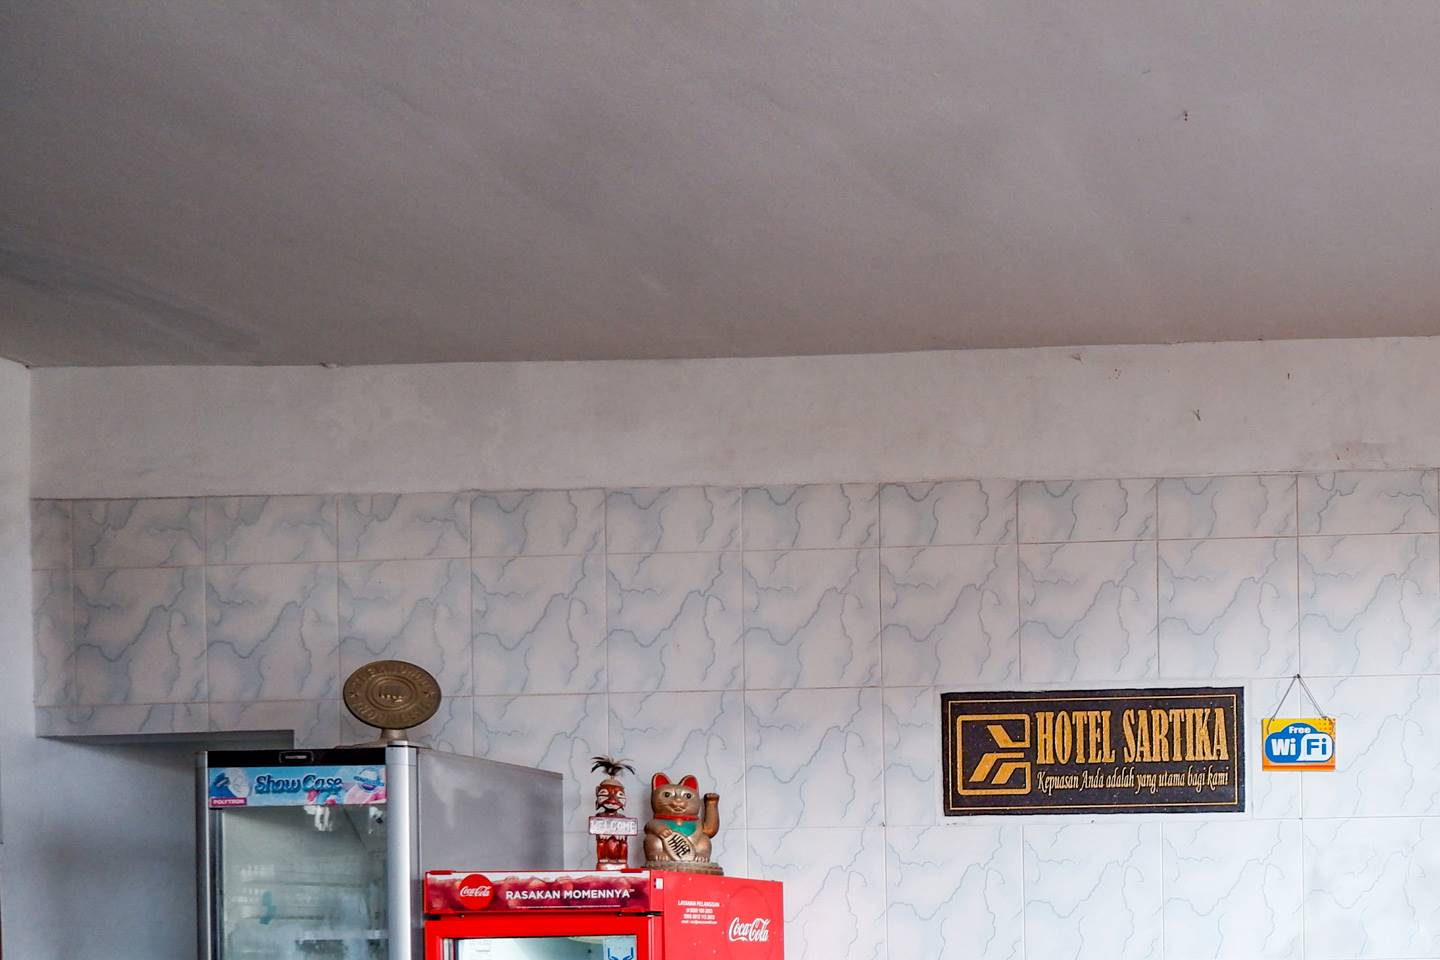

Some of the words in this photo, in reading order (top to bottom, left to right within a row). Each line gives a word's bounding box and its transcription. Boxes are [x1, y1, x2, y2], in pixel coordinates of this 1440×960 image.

[1035, 710, 1115, 765] HOTEL
[1122, 708, 1229, 763] SARTIKA
[1288, 726, 1311, 734] Free
[1037, 771, 1079, 796] Kepuasan
[1079, 767, 1104, 791] Anda
[1106, 766, 1134, 788] adalah
[1135, 773, 1156, 795] yang
[1158, 770, 1185, 787] utama
[1188, 765, 1206, 793] bagi
[1207, 765, 1229, 791] kami
[460, 885, 492, 897] Coca-Cola
[505, 890, 561, 899] RASAKAN
[728, 916, 771, 942] Coca-Cola
